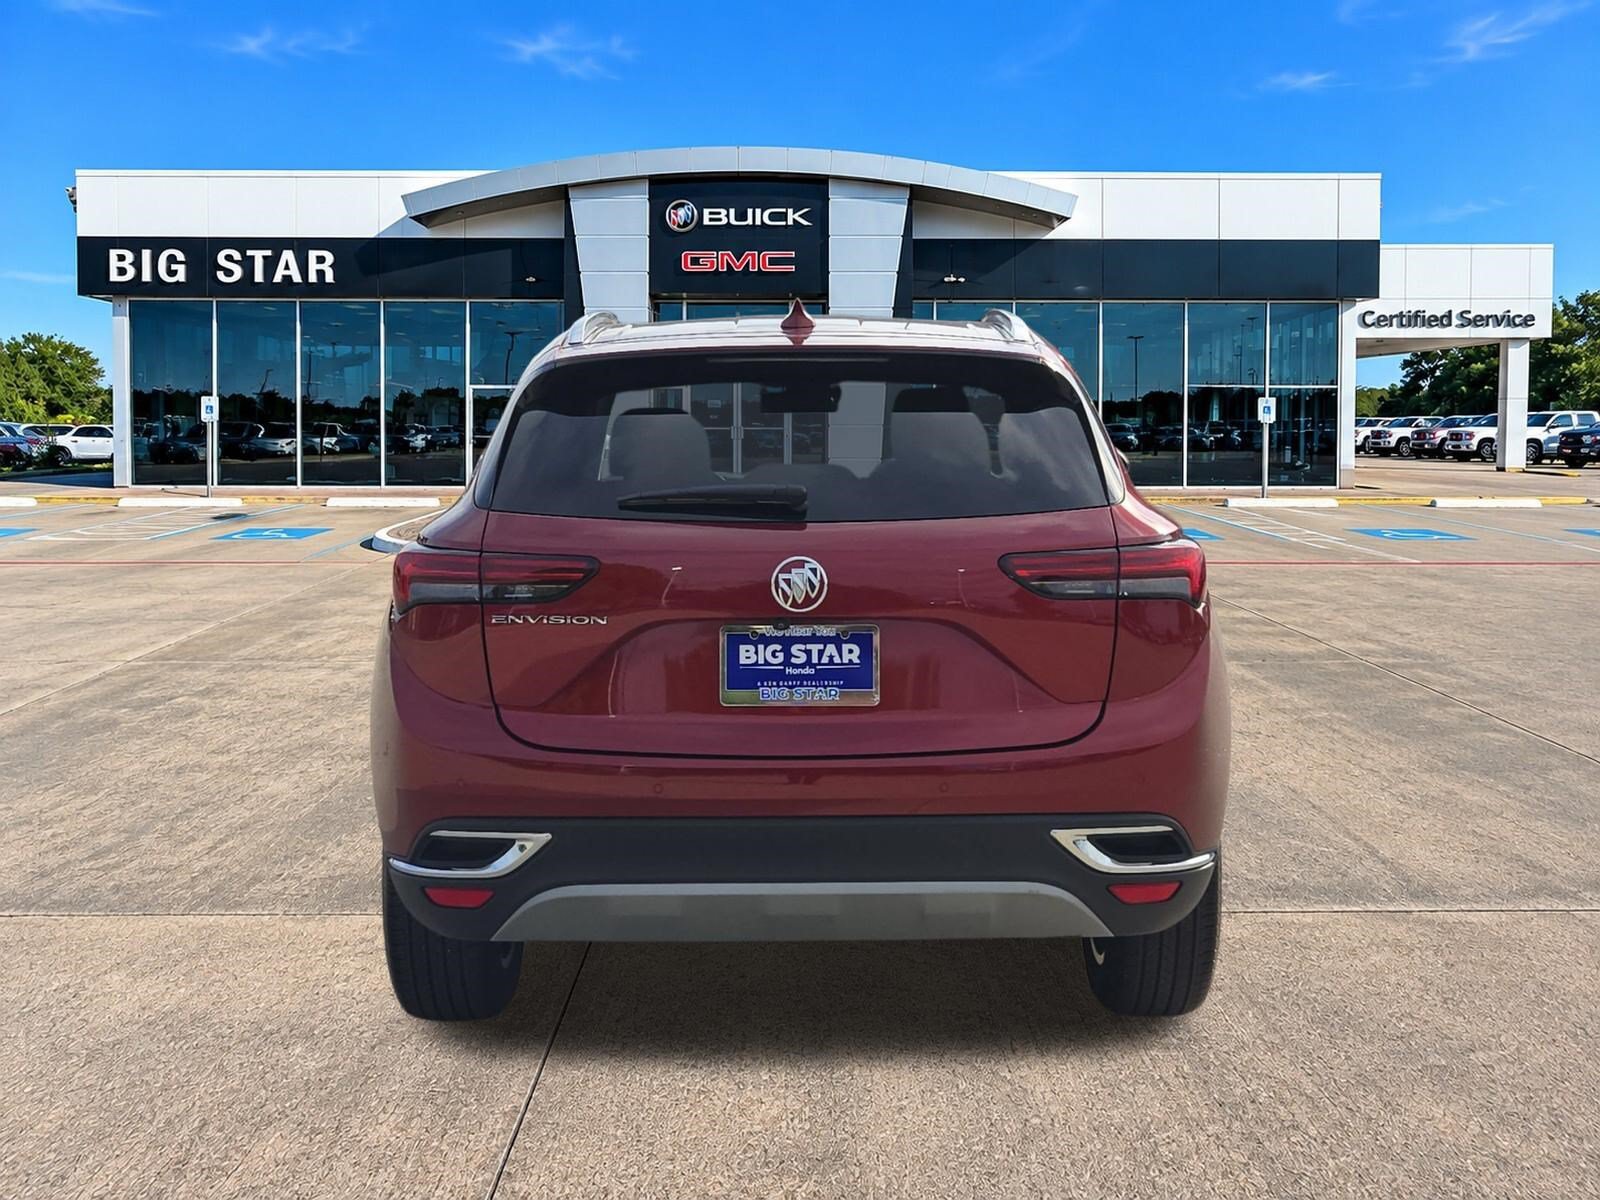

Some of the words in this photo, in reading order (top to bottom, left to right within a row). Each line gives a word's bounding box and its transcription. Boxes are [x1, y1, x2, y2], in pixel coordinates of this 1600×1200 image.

[703, 207, 813, 226] BUICK
[108, 248, 187, 283] BIG
[216, 249, 336, 284] STAR
[681, 250, 796, 272] GMC
[1360, 310, 1453, 328] Certified
[1456, 309, 1536, 329] Service
[491, 615, 608, 625] ENVISION
[739, 644, 785, 665] BIG
[790, 643, 862, 665] STAR
[785, 666, 816, 675] Honda
[759, 687, 790, 701] BIG
[793, 687, 840, 701] STAR
